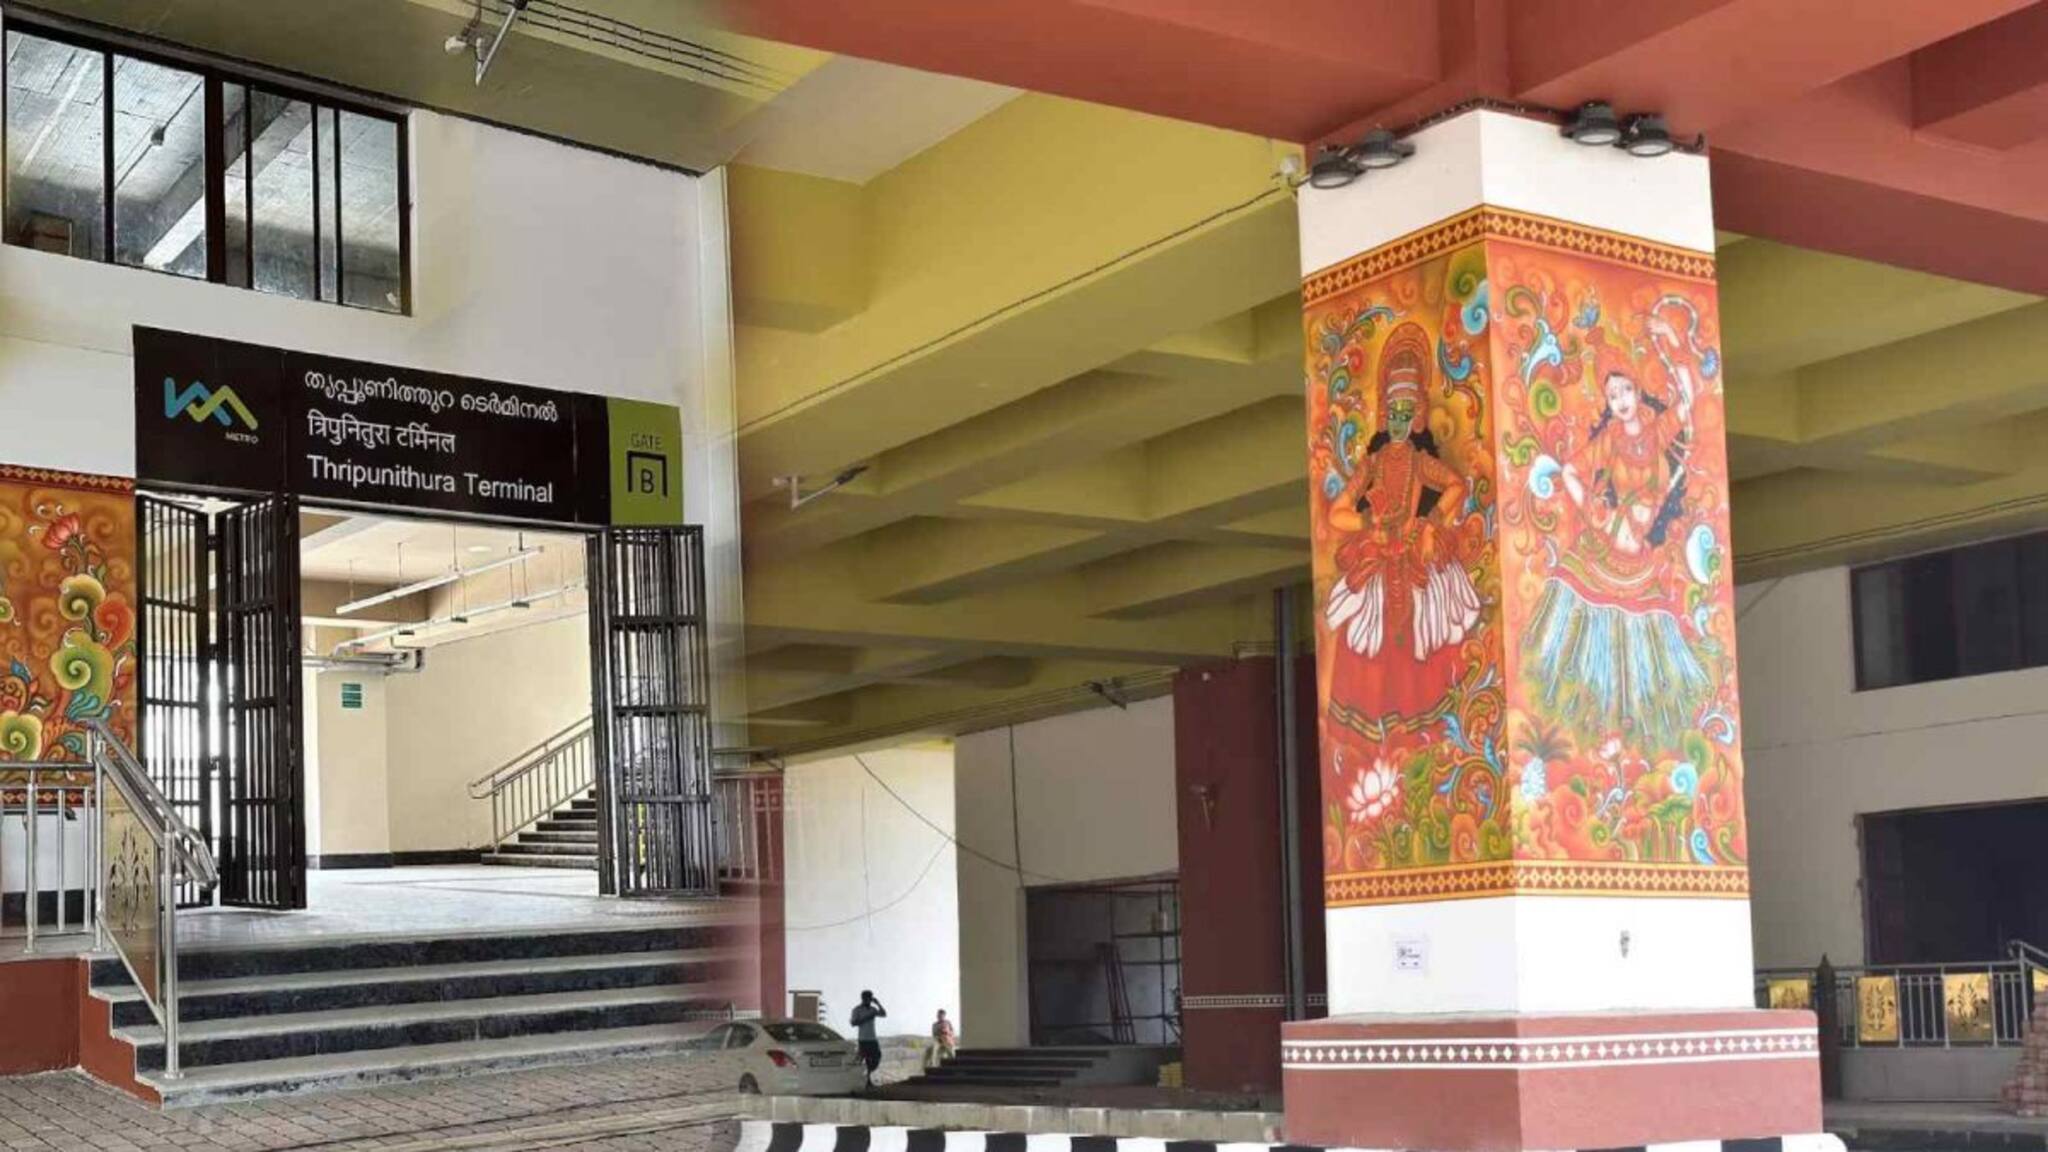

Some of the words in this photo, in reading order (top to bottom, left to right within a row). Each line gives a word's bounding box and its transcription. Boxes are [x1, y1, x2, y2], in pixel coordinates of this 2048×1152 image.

[305, 371, 455, 414] തൃപ്പൂണിത്തുറ
[460, 392, 559, 422] ടെർമിനൽ
[306, 408, 391, 449] त्रिपुनितुरा
[394, 421, 456, 453] टर्मिनल
[631, 433, 662, 449] GATE
[306, 454, 456, 495] Thripunithura
[463, 472, 554, 503] Terminal
[641, 468, 655, 494] B
